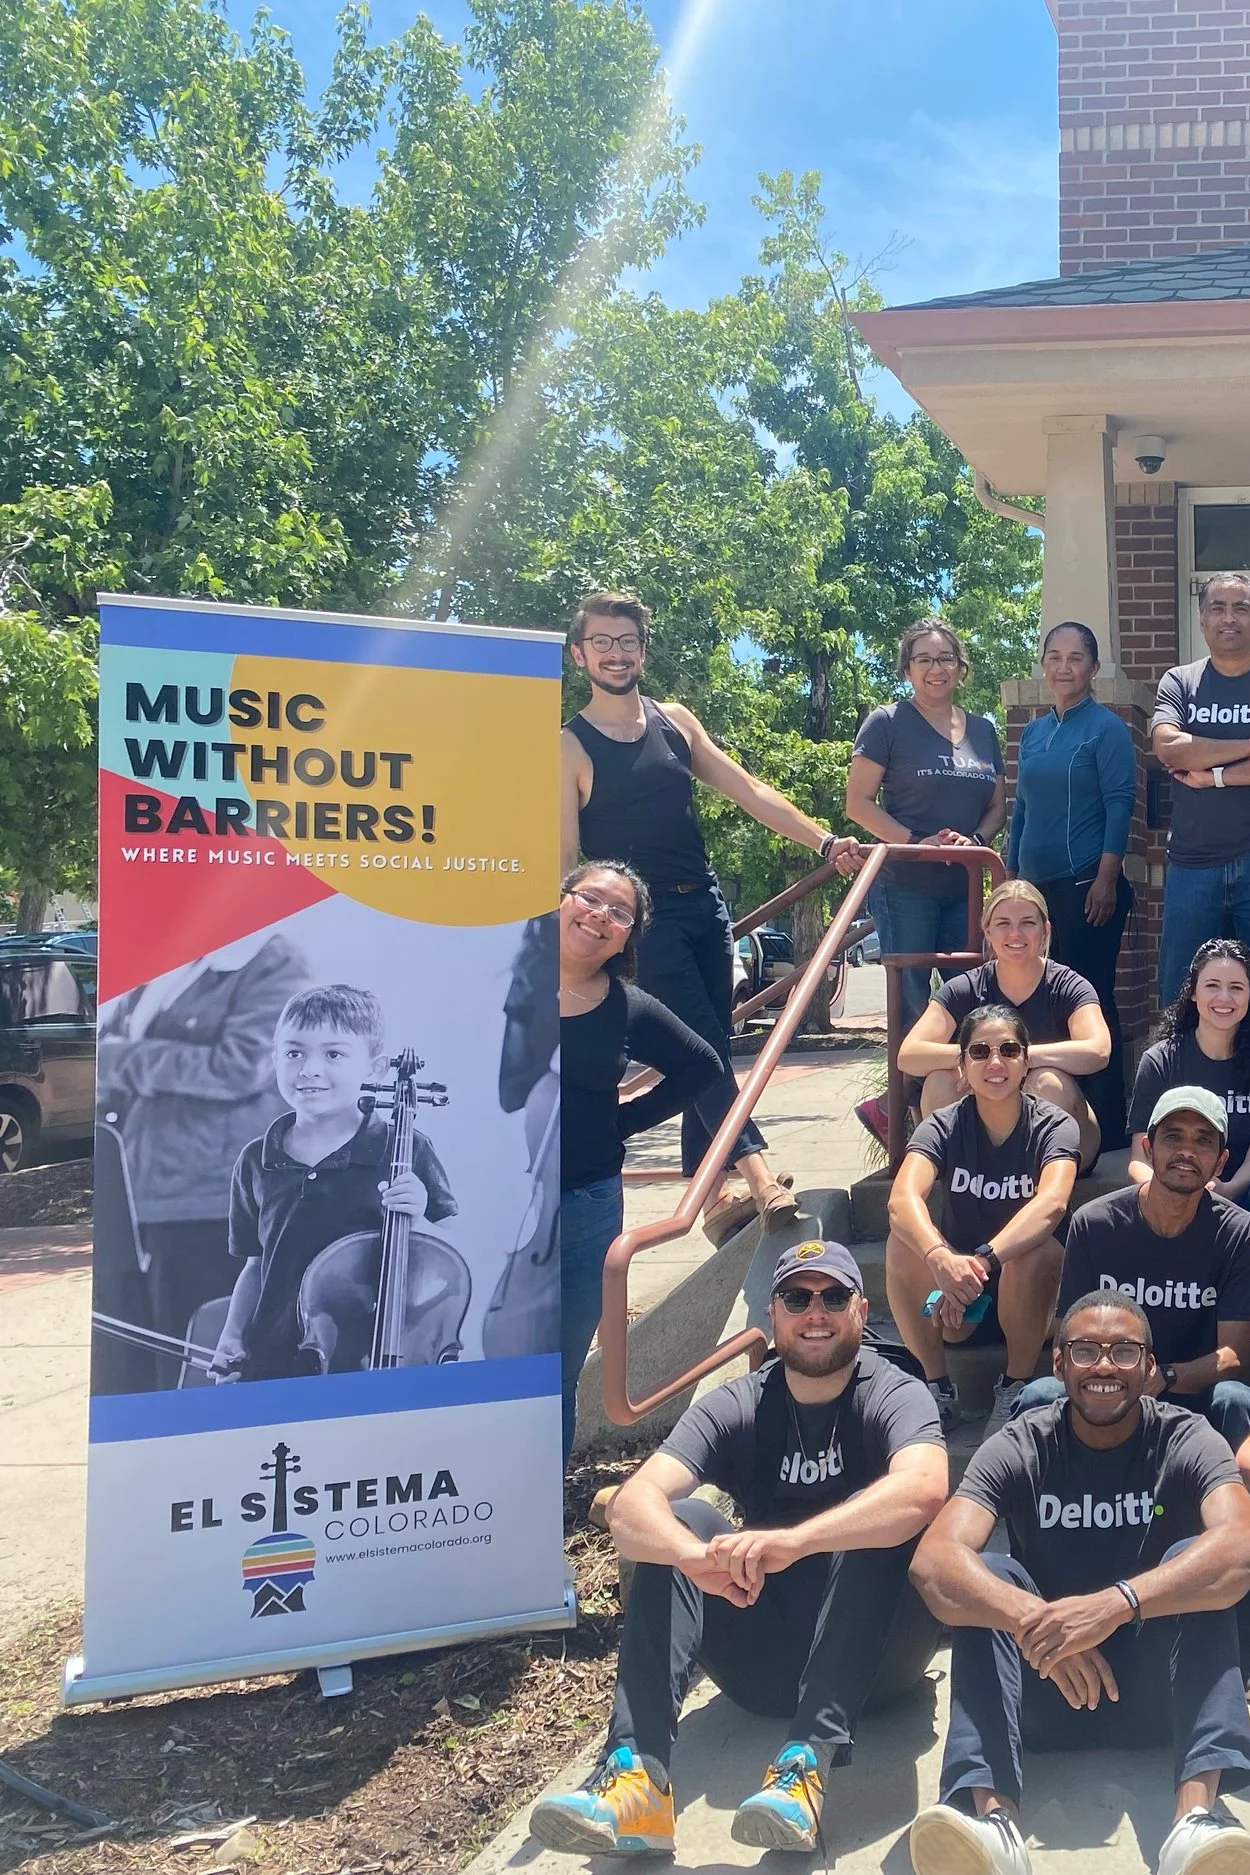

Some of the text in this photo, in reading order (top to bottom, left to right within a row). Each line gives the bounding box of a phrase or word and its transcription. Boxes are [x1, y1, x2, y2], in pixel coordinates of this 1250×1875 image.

[125, 682, 327, 732] MUSIC
[124, 738, 413, 790] WITHOUT
[943, 769, 985, 780] COLORADO
[124, 794, 437, 844] BARRIERS!
[121, 847, 527, 875] WHERE MUSIC MEETS SOCIAL JUSTICE.
[950, 1167, 1037, 1200] Deloitt
[170, 1498, 224, 1533] EL
[324, 1501, 494, 1541] COLORADO
[325, 1533, 493, 1565] www.elsistemacolorado.org
